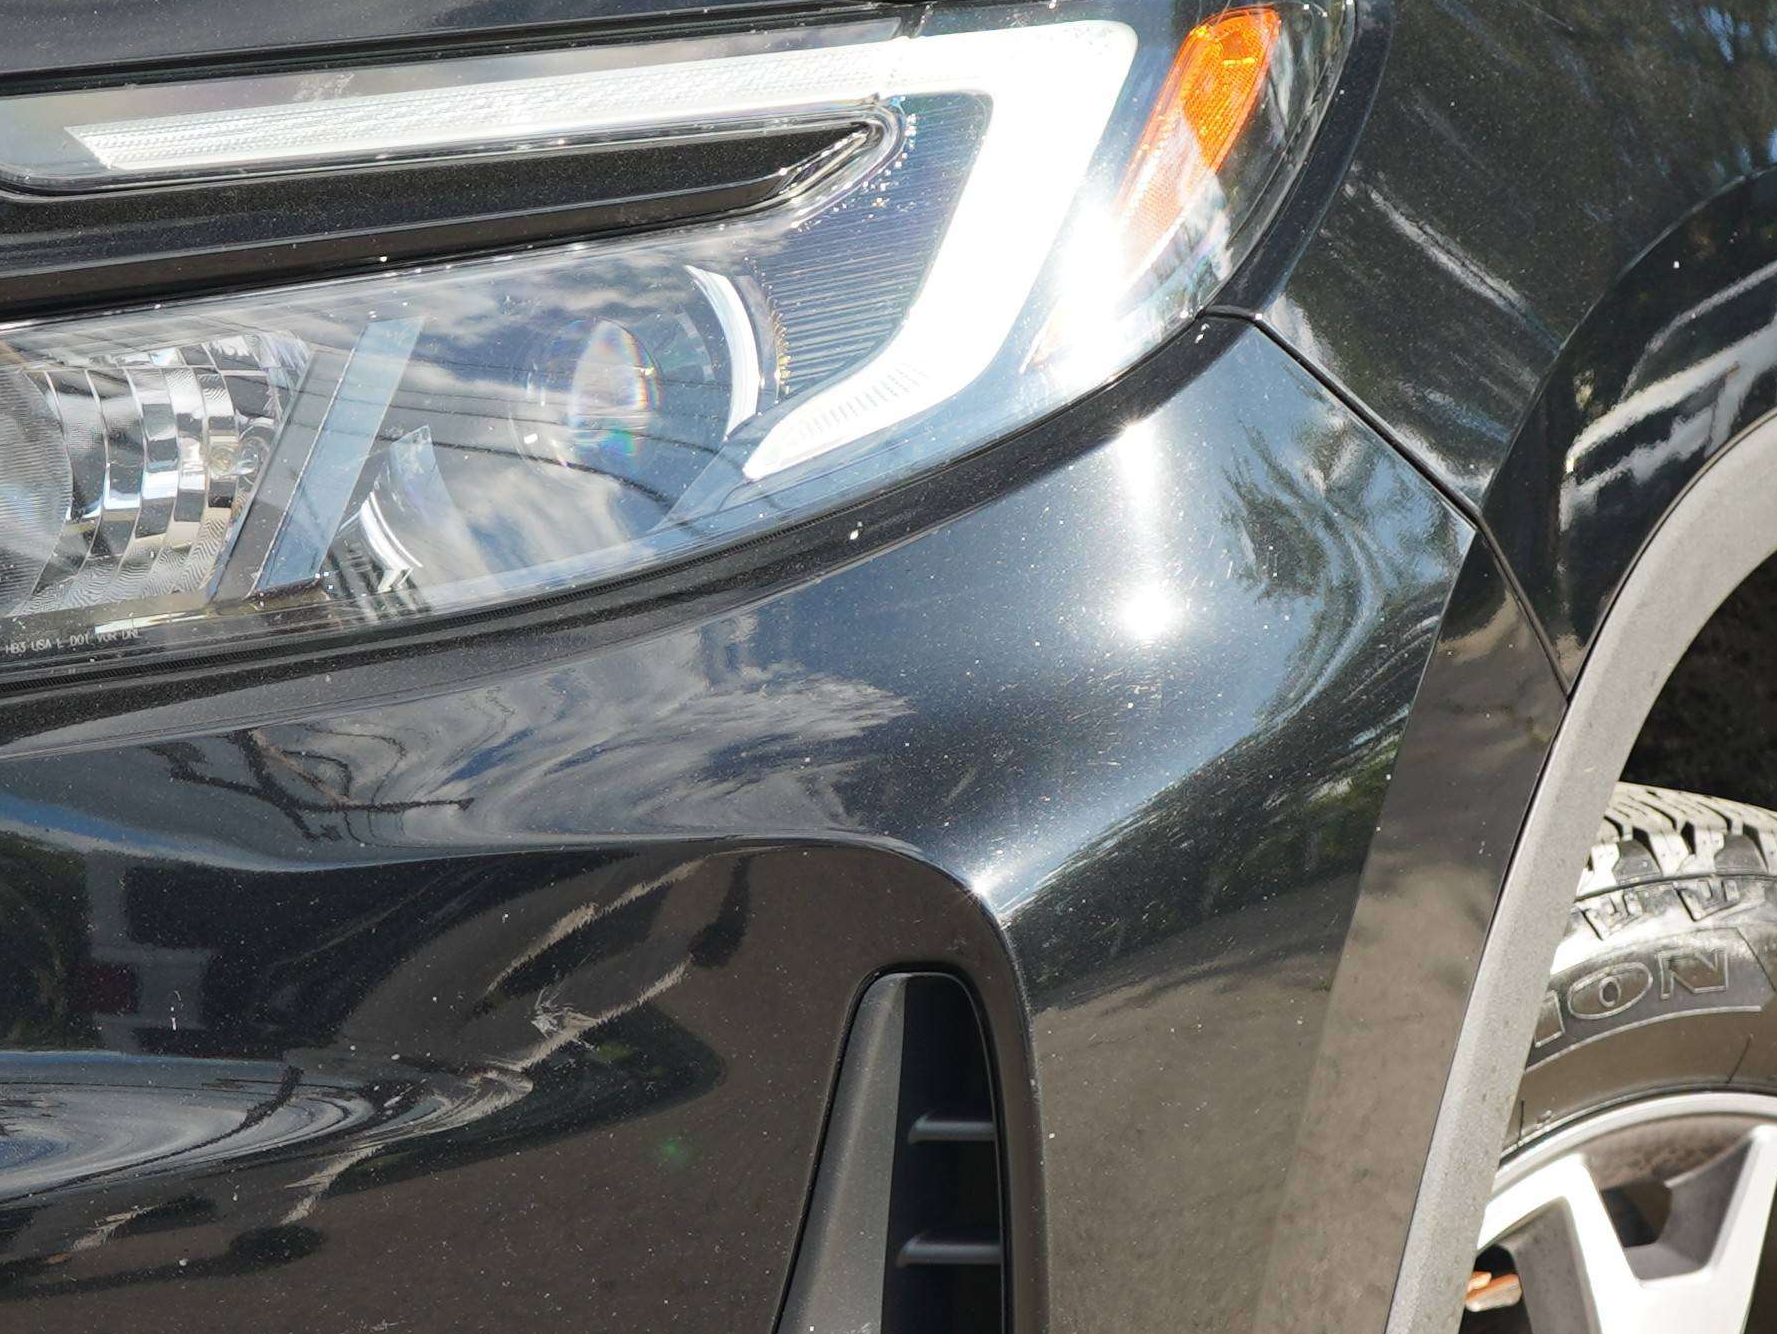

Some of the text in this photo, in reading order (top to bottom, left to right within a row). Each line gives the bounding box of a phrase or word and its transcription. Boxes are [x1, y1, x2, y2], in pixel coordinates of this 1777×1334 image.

[5, 641, 26, 654] HB3
[31, 638, 52, 652] USA
[69, 633, 90, 646] DOT
